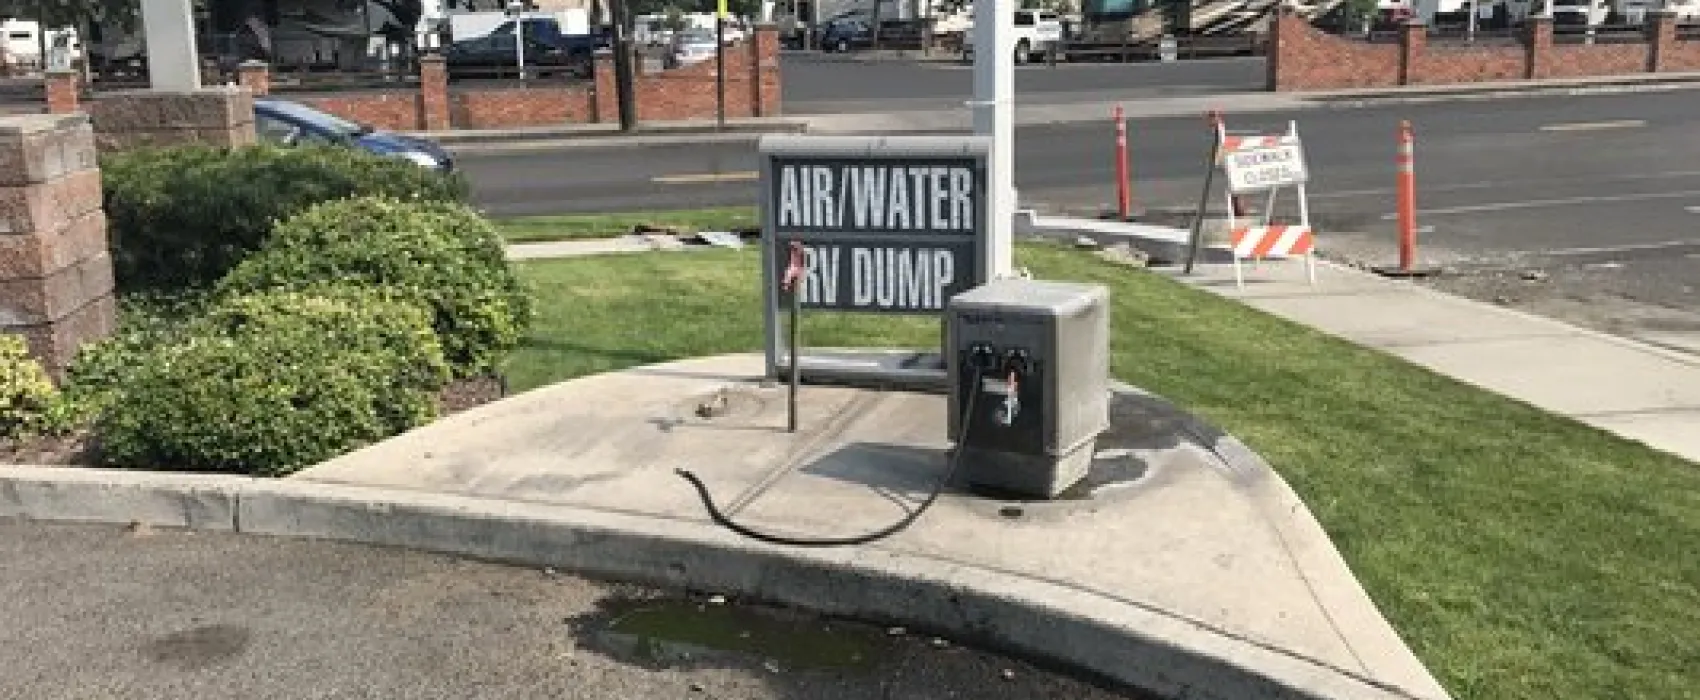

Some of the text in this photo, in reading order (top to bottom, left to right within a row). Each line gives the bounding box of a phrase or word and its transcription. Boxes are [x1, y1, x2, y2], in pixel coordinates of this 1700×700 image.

[779, 165, 974, 229] AIR/WATER
[800, 247, 954, 308] RV DUMP
